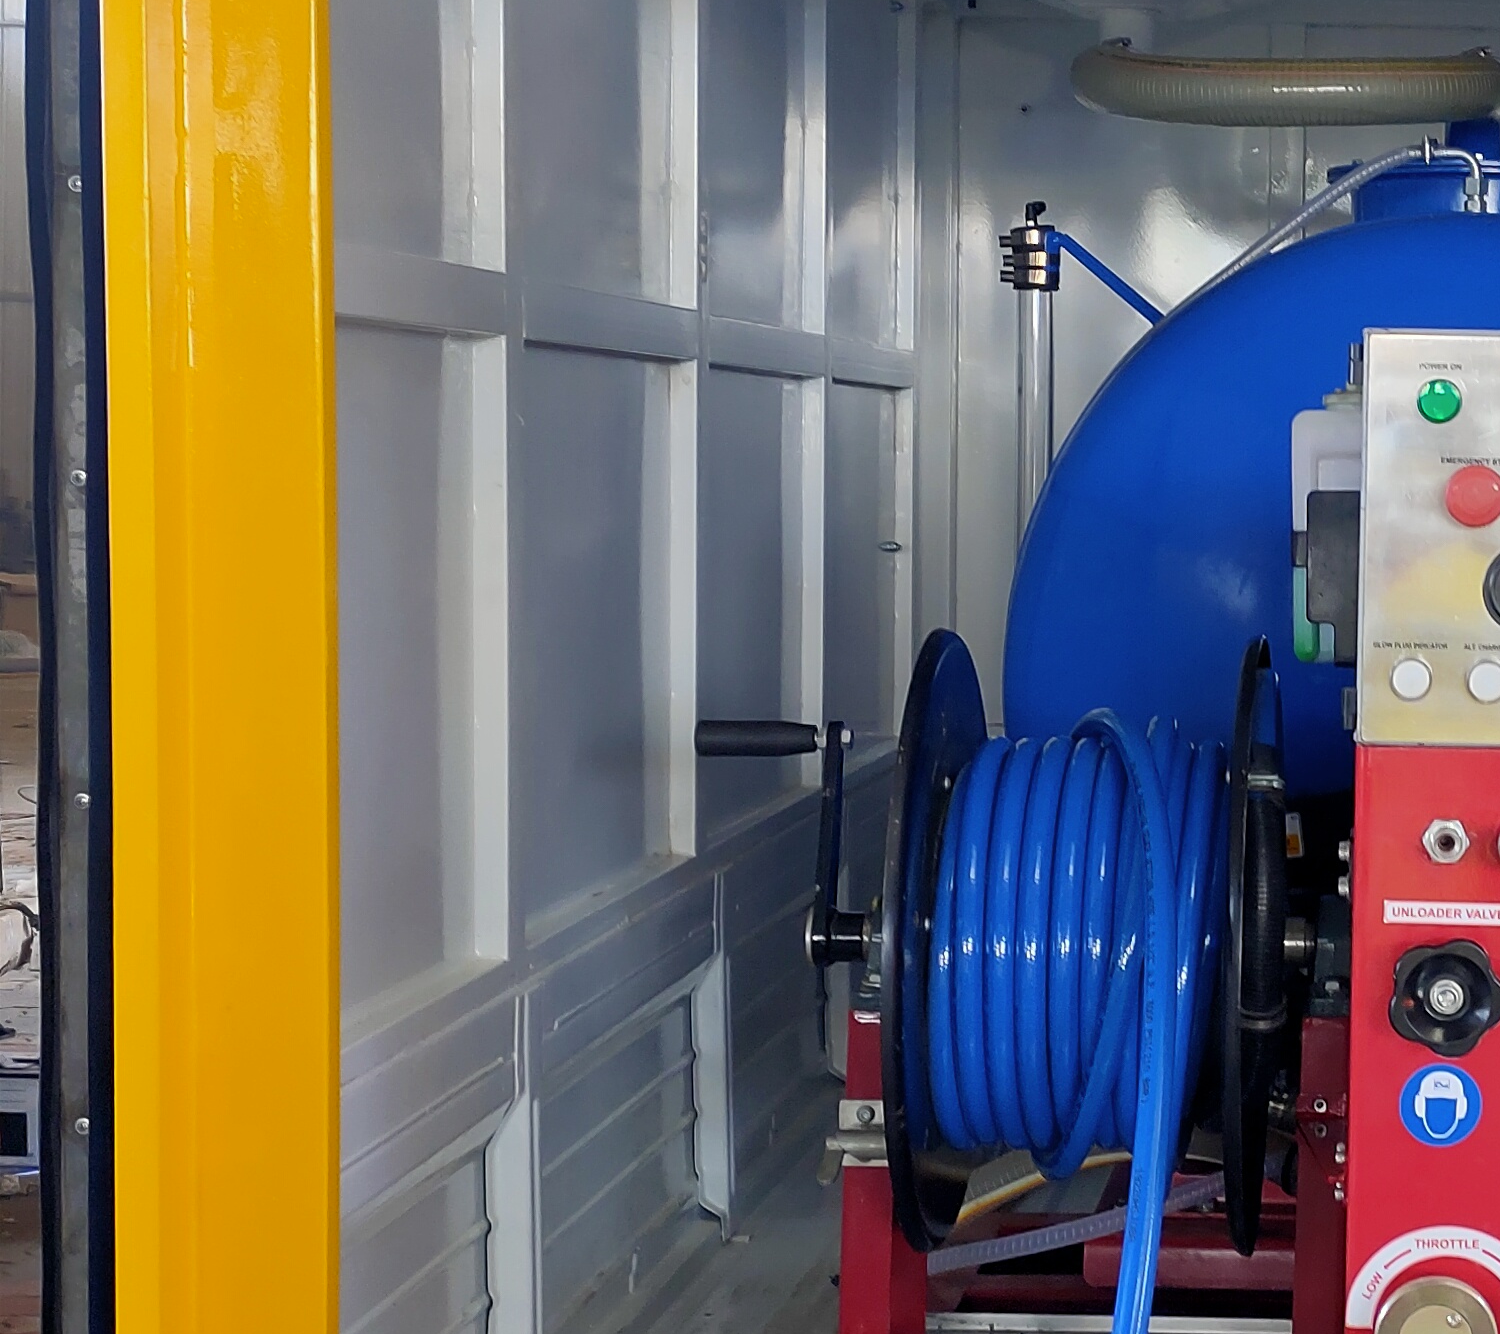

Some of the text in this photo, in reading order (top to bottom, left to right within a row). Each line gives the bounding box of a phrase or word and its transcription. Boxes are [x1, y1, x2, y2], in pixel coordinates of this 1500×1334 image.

[1391, 907, 1462, 919] UNLOADER
[1415, 1238, 1480, 1250] THROTTLE
[1362, 1271, 1384, 1300] LOW
